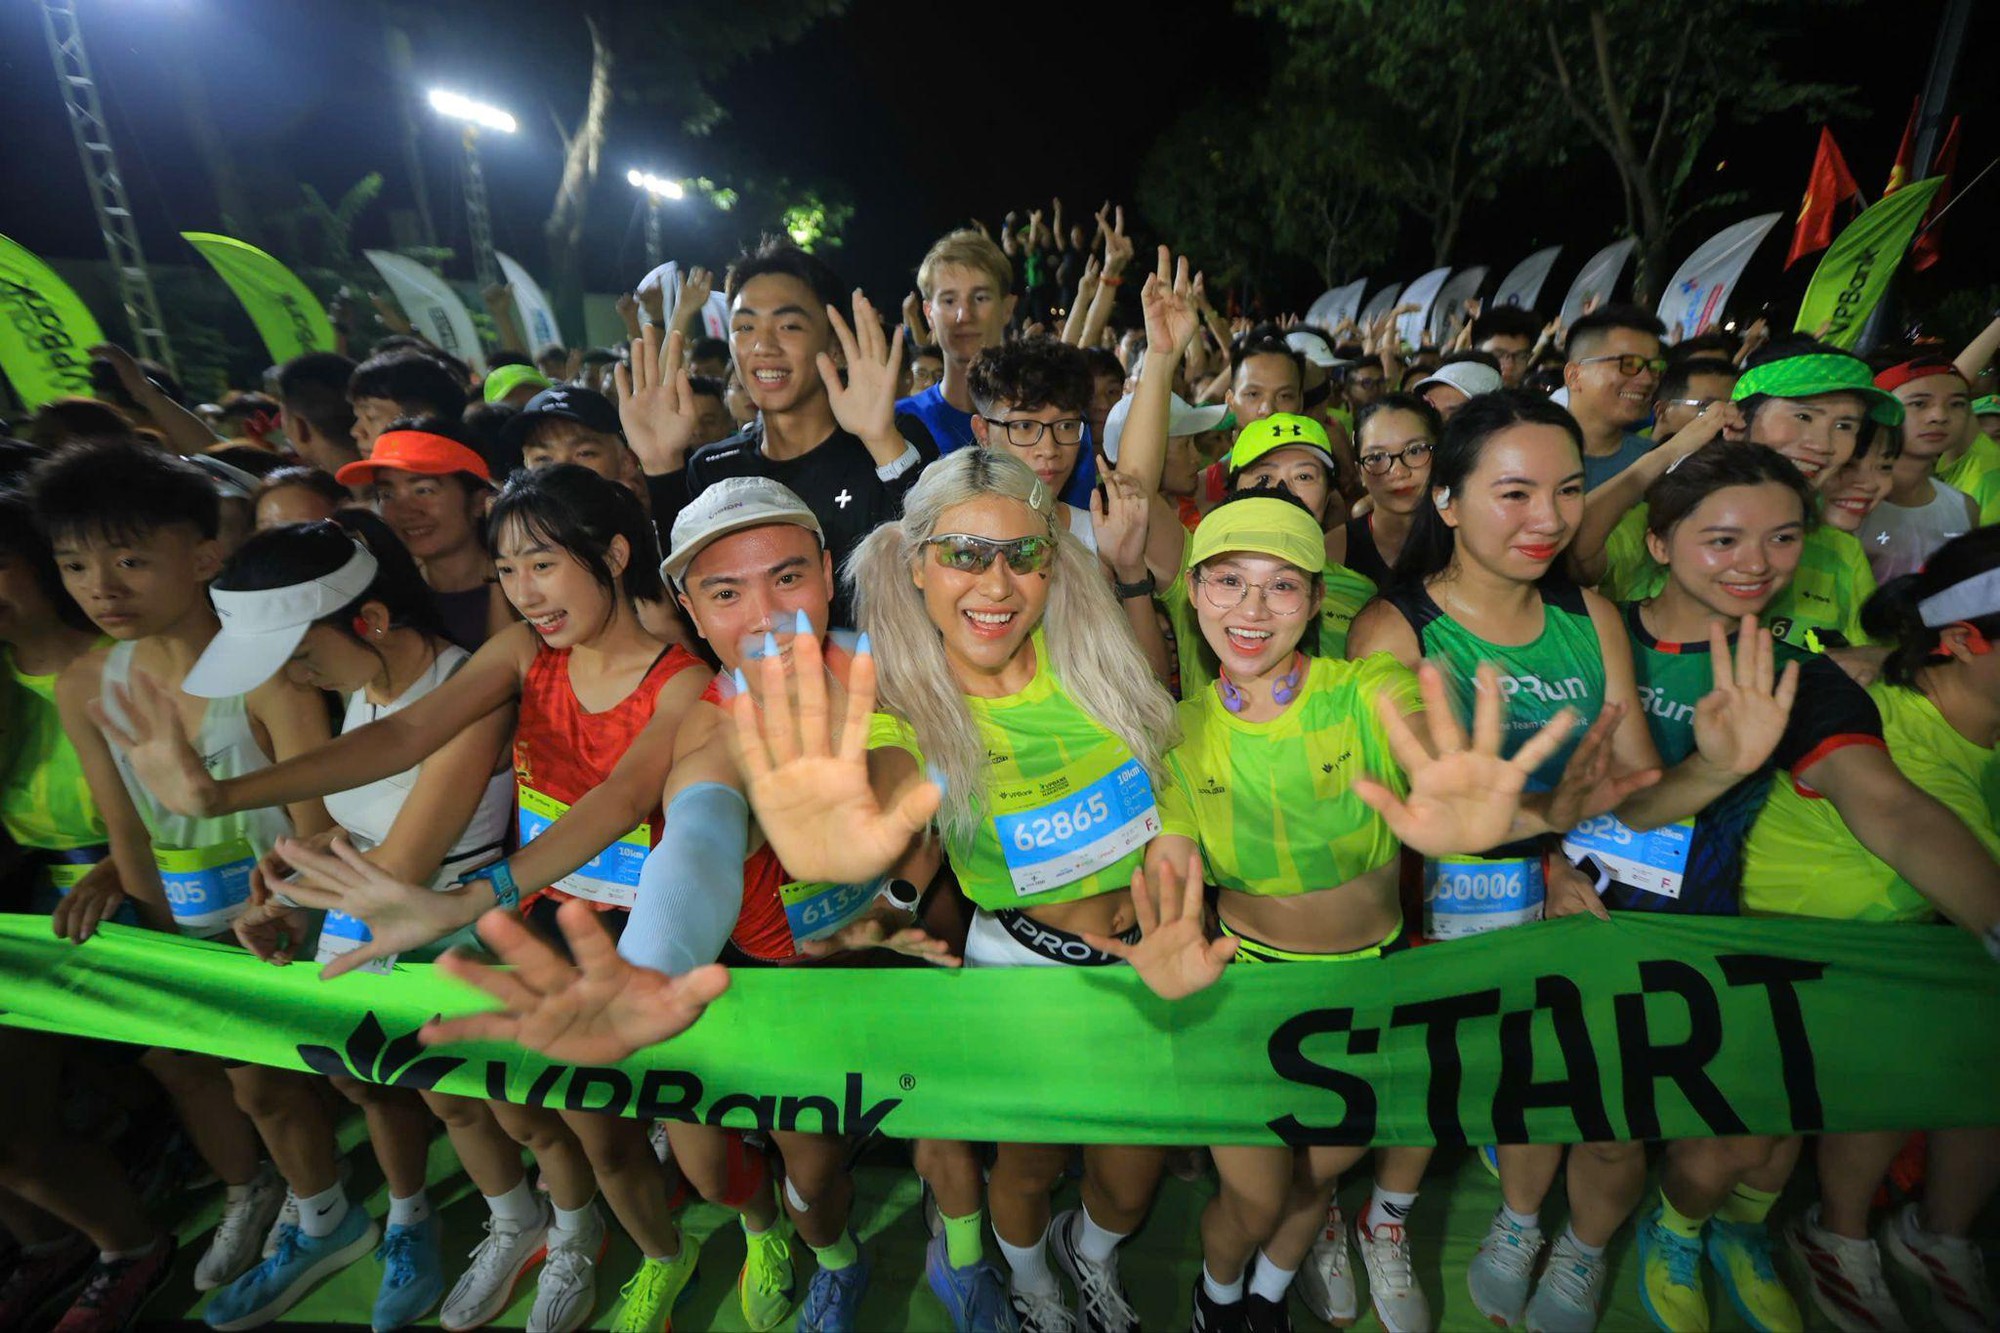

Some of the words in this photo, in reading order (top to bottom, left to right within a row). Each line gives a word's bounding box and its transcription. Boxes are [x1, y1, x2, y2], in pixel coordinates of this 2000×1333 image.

[1827, 250, 1880, 334] VPBank
[1117, 766, 1140, 785] 10km
[1014, 792, 1109, 851] 62865
[1144, 818, 1154, 832] F
[618, 847, 645, 860] 10km
[1437, 872, 1521, 900] 60006
[1660, 877, 1672, 888] F
[1012, 916, 1092, 961] PRO
[1266, 954, 1833, 1148] START
